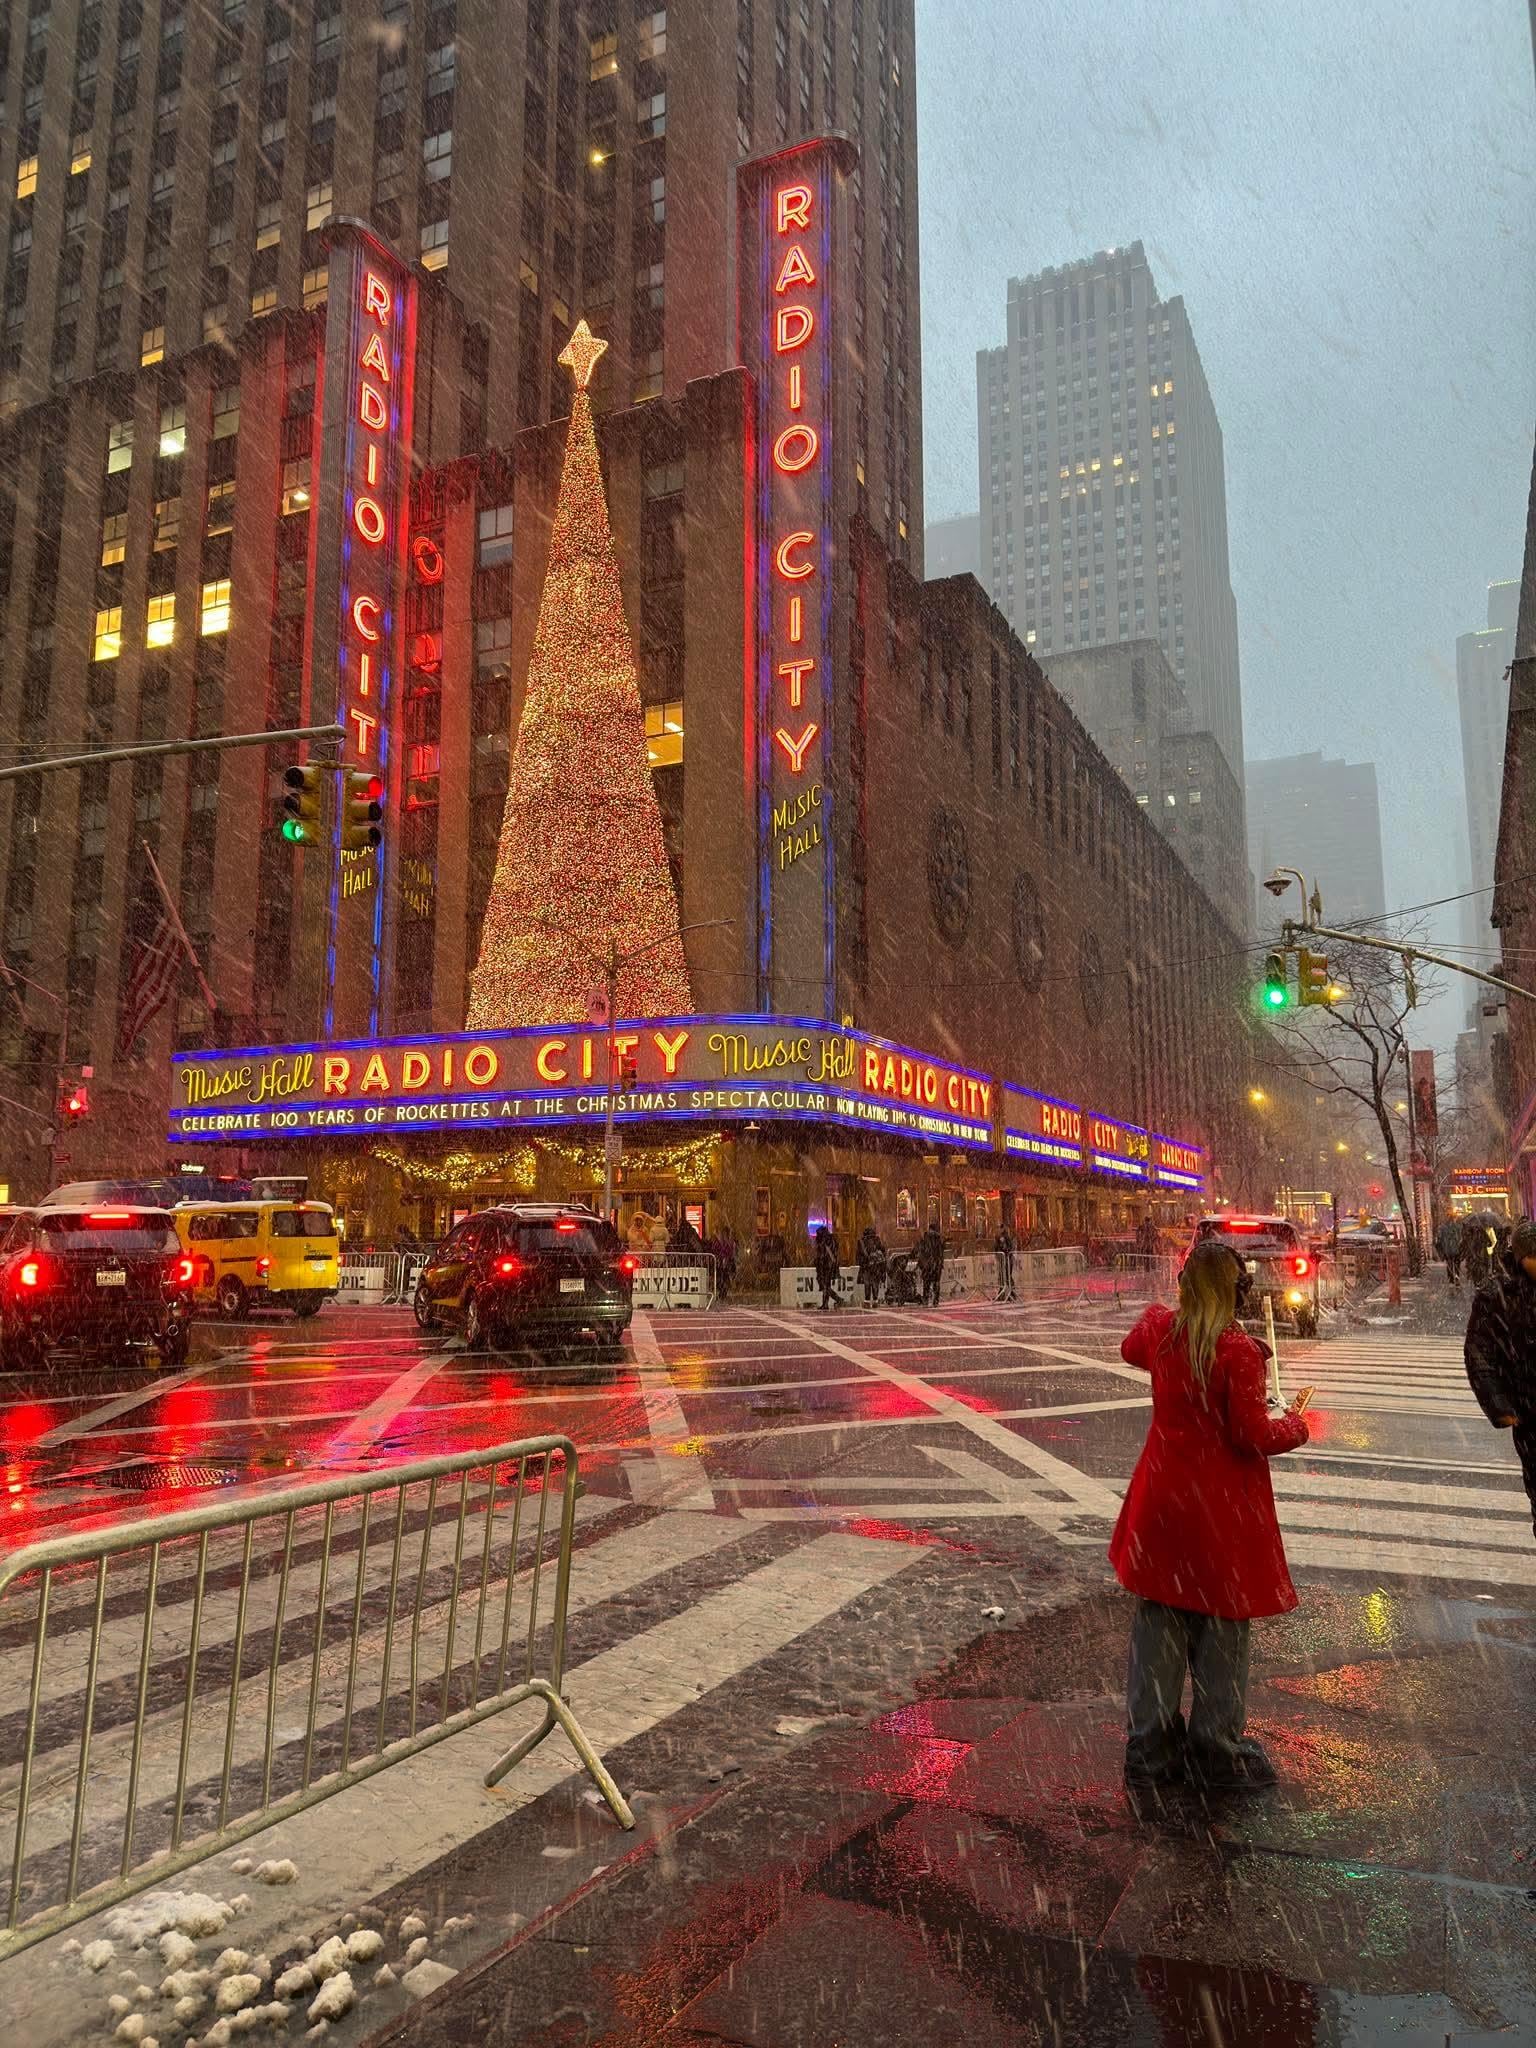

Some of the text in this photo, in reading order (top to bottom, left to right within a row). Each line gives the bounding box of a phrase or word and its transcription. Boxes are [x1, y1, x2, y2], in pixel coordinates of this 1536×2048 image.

[774, 185, 818, 472] RADIO
[354, 272, 391, 543] RADIO
[350, 595, 380, 756] CIT
[776, 531, 817, 772] CITY
[773, 784, 821, 837] MUSIC
[780, 823, 821, 871] HALL
[344, 867, 373, 898] HALL
[181, 1031, 991, 1116] Music Hall RADIO CITY Music Hall RADIO CITY
[181, 1113, 261, 1131] CELEBRATE
[308, 1108, 355, 1125] YEARS
[365, 1107, 385, 1123] OF
[396, 1103, 489, 1121] ROCKETTES
[501, 1100, 520, 1115] AT
[535, 1098, 564, 1114] THE
[576, 1092, 677, 1113] CHRISTMAS
[691, 1091, 830, 1110] SPECTACULAR!
[837, 1097, 854, 1115] NOW
[858, 1099, 888, 1123] PLAYING
[892, 1110, 906, 1125] THIS
[1042, 1104, 1081, 1140] RADIO
[1094, 1121, 1118, 1150] CITY
